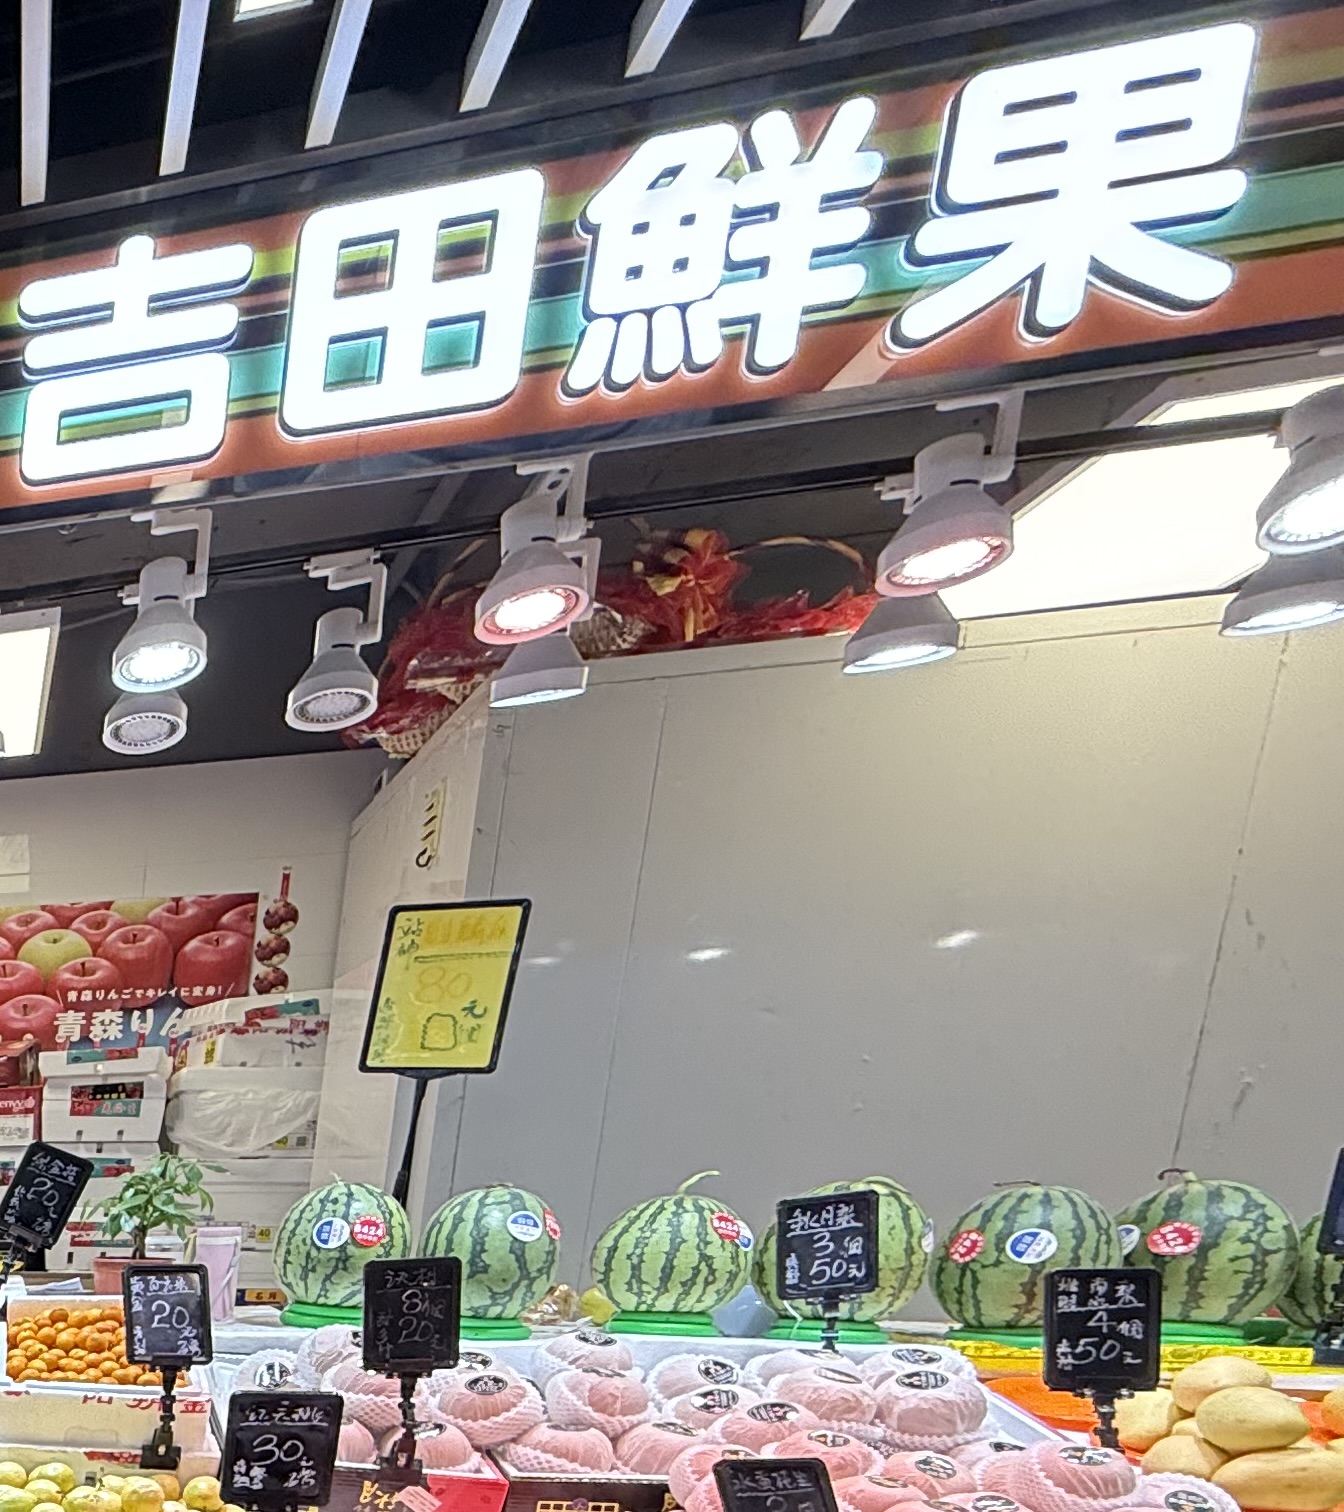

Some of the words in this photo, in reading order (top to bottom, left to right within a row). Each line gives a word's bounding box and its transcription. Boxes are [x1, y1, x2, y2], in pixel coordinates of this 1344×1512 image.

[18, 22, 1255, 487] 吉田鮮果
[151, 1299, 190, 1329] 20
[250, 1433, 305, 1466] 30
